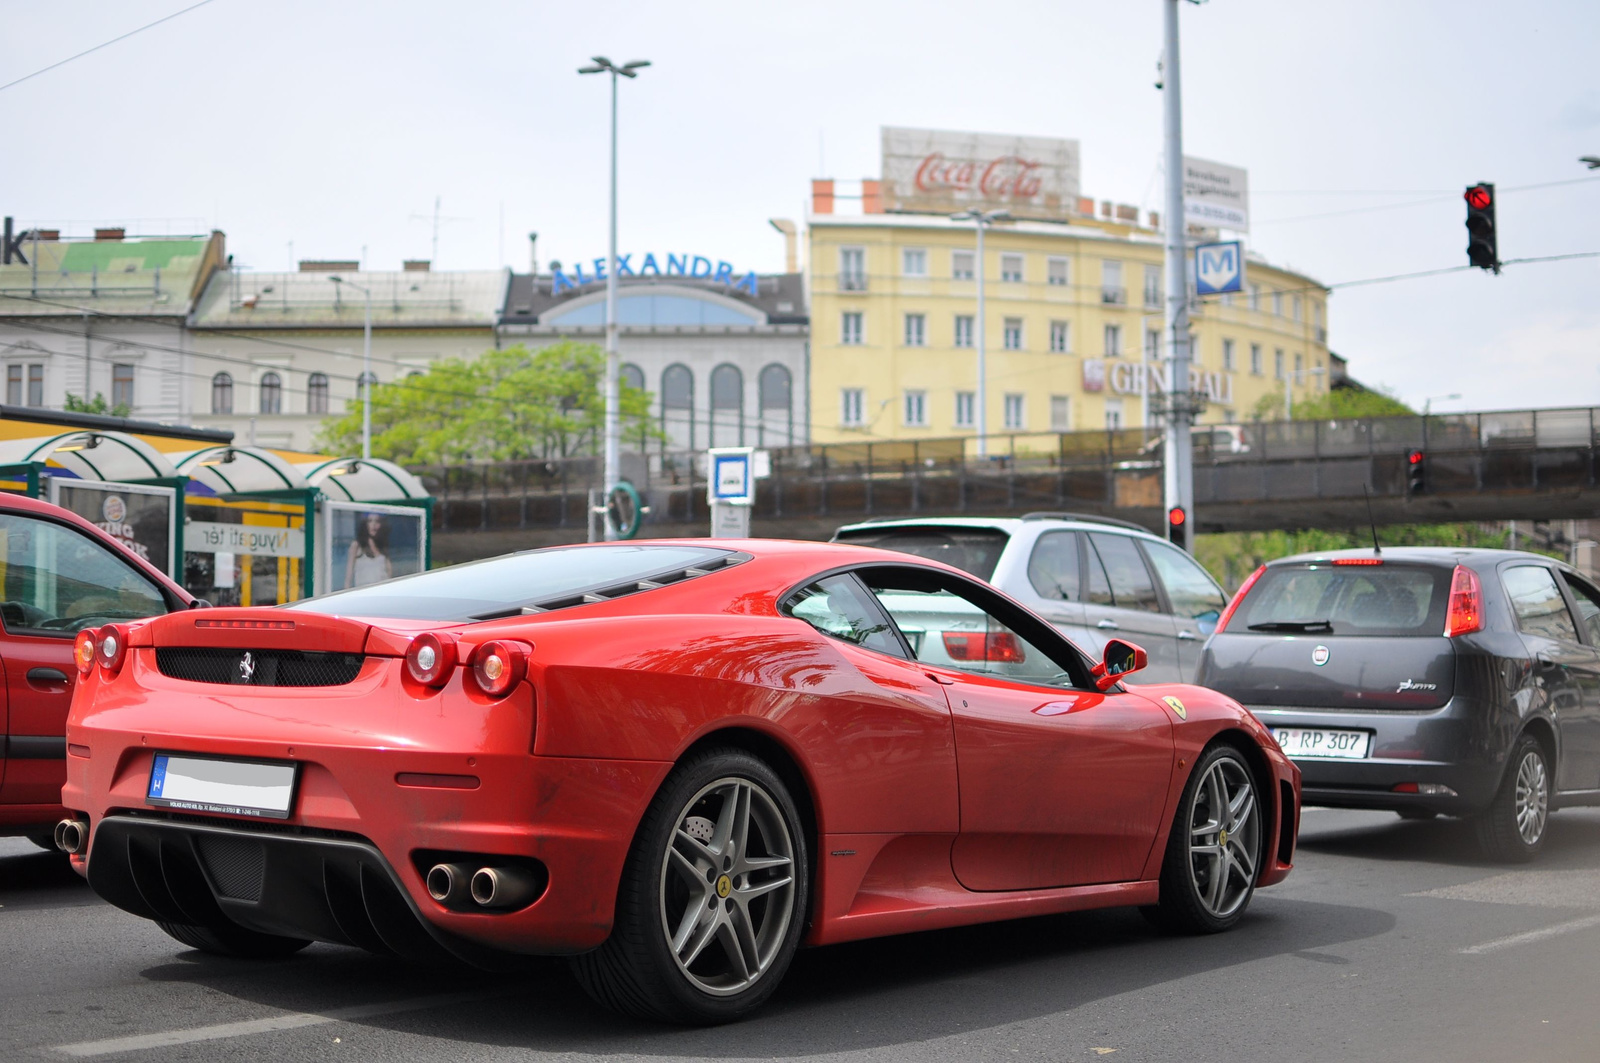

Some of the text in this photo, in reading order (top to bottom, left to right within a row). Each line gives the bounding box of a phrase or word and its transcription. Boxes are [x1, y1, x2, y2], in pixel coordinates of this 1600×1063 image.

[3, 216, 29, 265] k
[551, 252, 759, 297] ALEXANDRA
[1110, 361, 1233, 404] GENRALI
[1300, 731, 1323, 748] RP
[1327, 732, 1361, 750] 307
